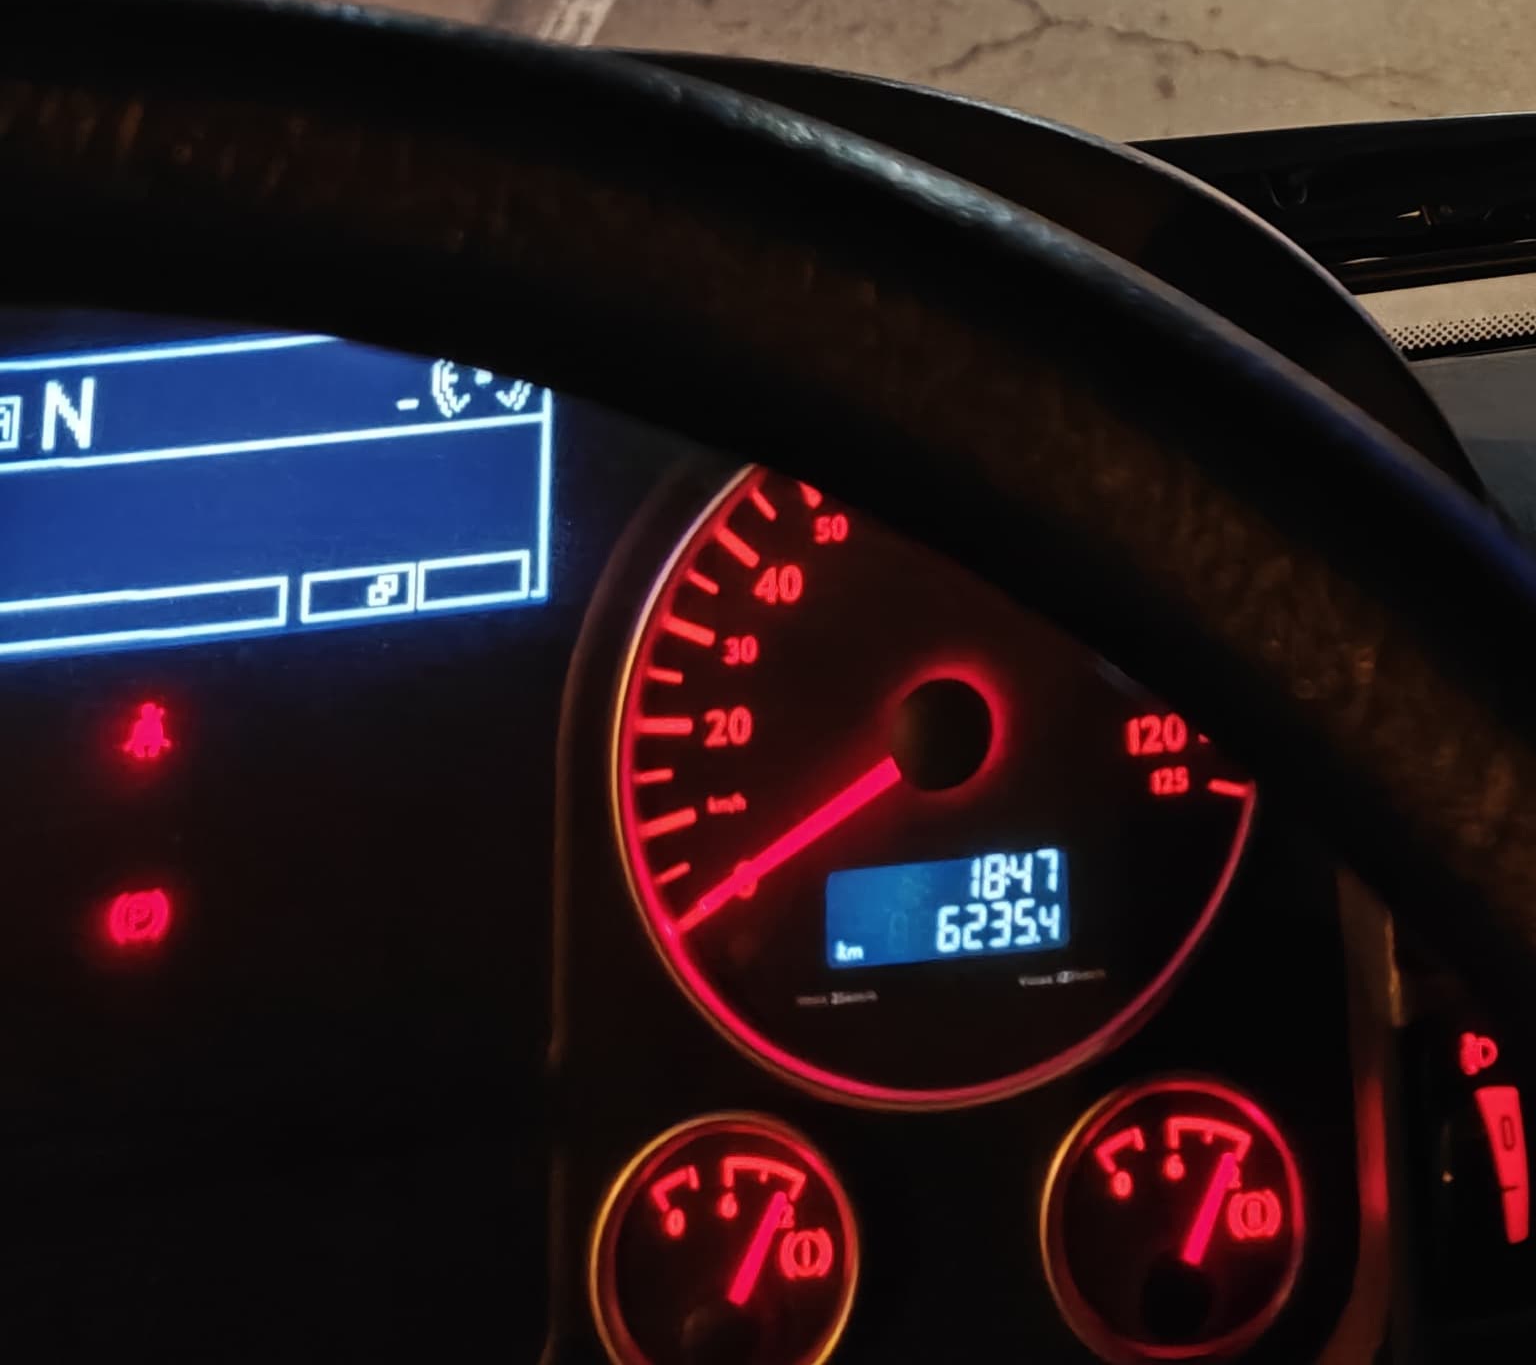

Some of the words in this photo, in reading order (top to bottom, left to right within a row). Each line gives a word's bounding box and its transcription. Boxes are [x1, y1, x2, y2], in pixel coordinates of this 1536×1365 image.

[41, 376, 96, 451] N
[814, 513, 849, 544] 50
[754, 563, 804, 606] 40
[722, 634, 760, 667] 30
[703, 705, 753, 748] 20
[1125, 713, 1188, 756] 120
[1150, 765, 1190, 796] 125
[706, 791, 748, 815] km/h
[970, 847, 1061, 901] 18:47
[836, 942, 864, 962] km
[936, 897, 1062, 954] 6235.4
